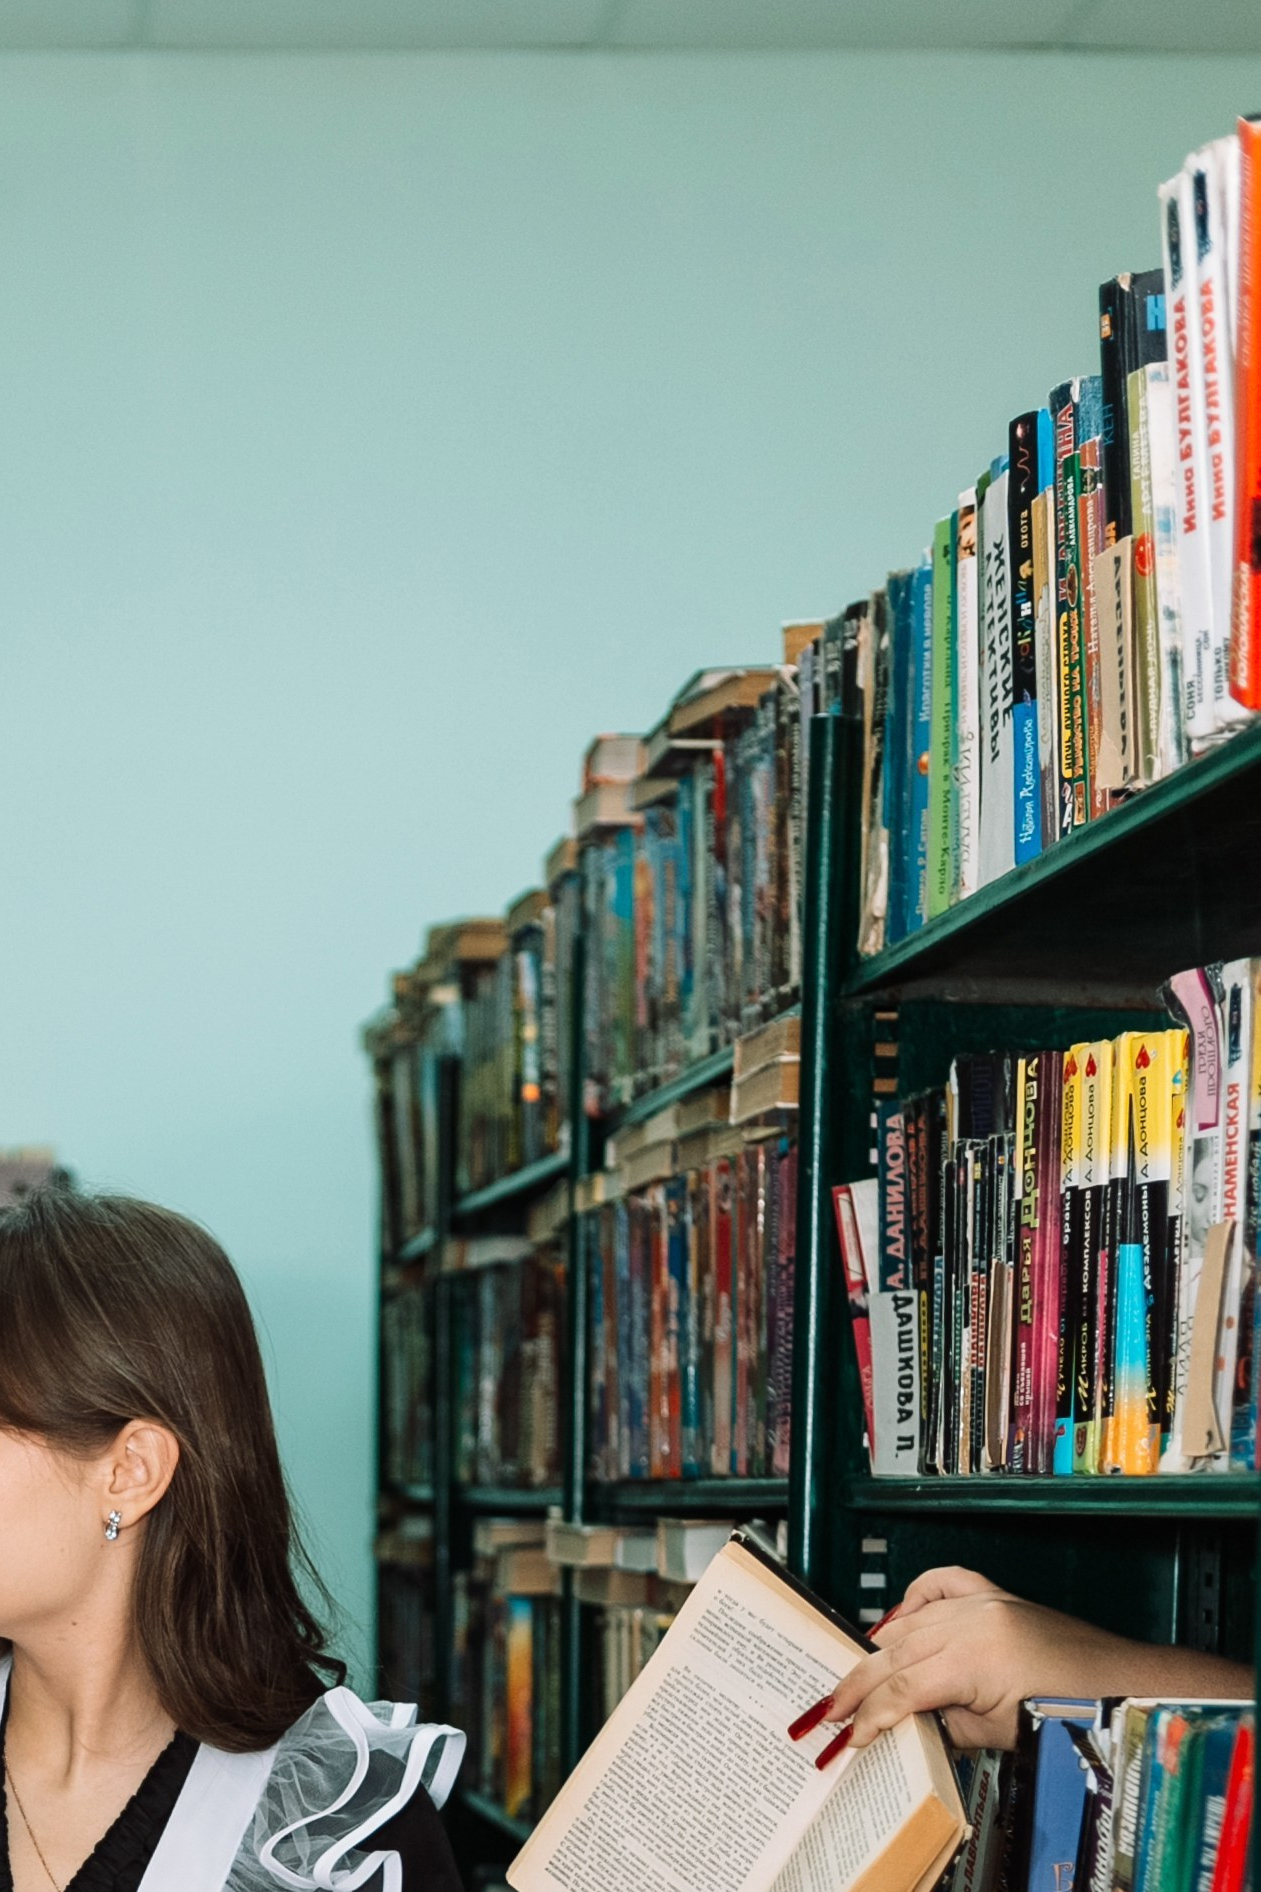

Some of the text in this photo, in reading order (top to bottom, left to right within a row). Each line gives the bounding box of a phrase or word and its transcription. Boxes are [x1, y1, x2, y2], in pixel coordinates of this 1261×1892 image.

[1131, 429, 1142, 481] ГАЛИНА
[1173, 293, 1198, 535] Инна БУЛГАКОВА
[1198, 278, 1227, 522] Инна БУЛГАКОВА
[1066, 475, 1076, 546] АЛЕКСАНДРОВА
[1082, 497, 1099, 654] Наталья Александрова
[1113, 555, 1128, 756] АРСЕНЬЕВА
[1213, 646, 1226, 702] ТОЛЬКО
[1196, 1030, 1208, 1076] ГРЕХИ
[1201, 1004, 1218, 1098] ПРОШЛОГО
[1084, 1084, 1096, 1163] Донцова
[1138, 1076, 1149, 1157] Донцова
[1222, 1081, 1240, 1217] НАМЕНСКАЯ
[885, 1112, 906, 1290] А. ДАНИЛОВА
[1140, 1185, 1152, 1290] Дездемоны
[891, 1293, 914, 1424] ДАШКОВА
[963, 1769, 992, 1886] ЛАВРЕНТЬЕВА
